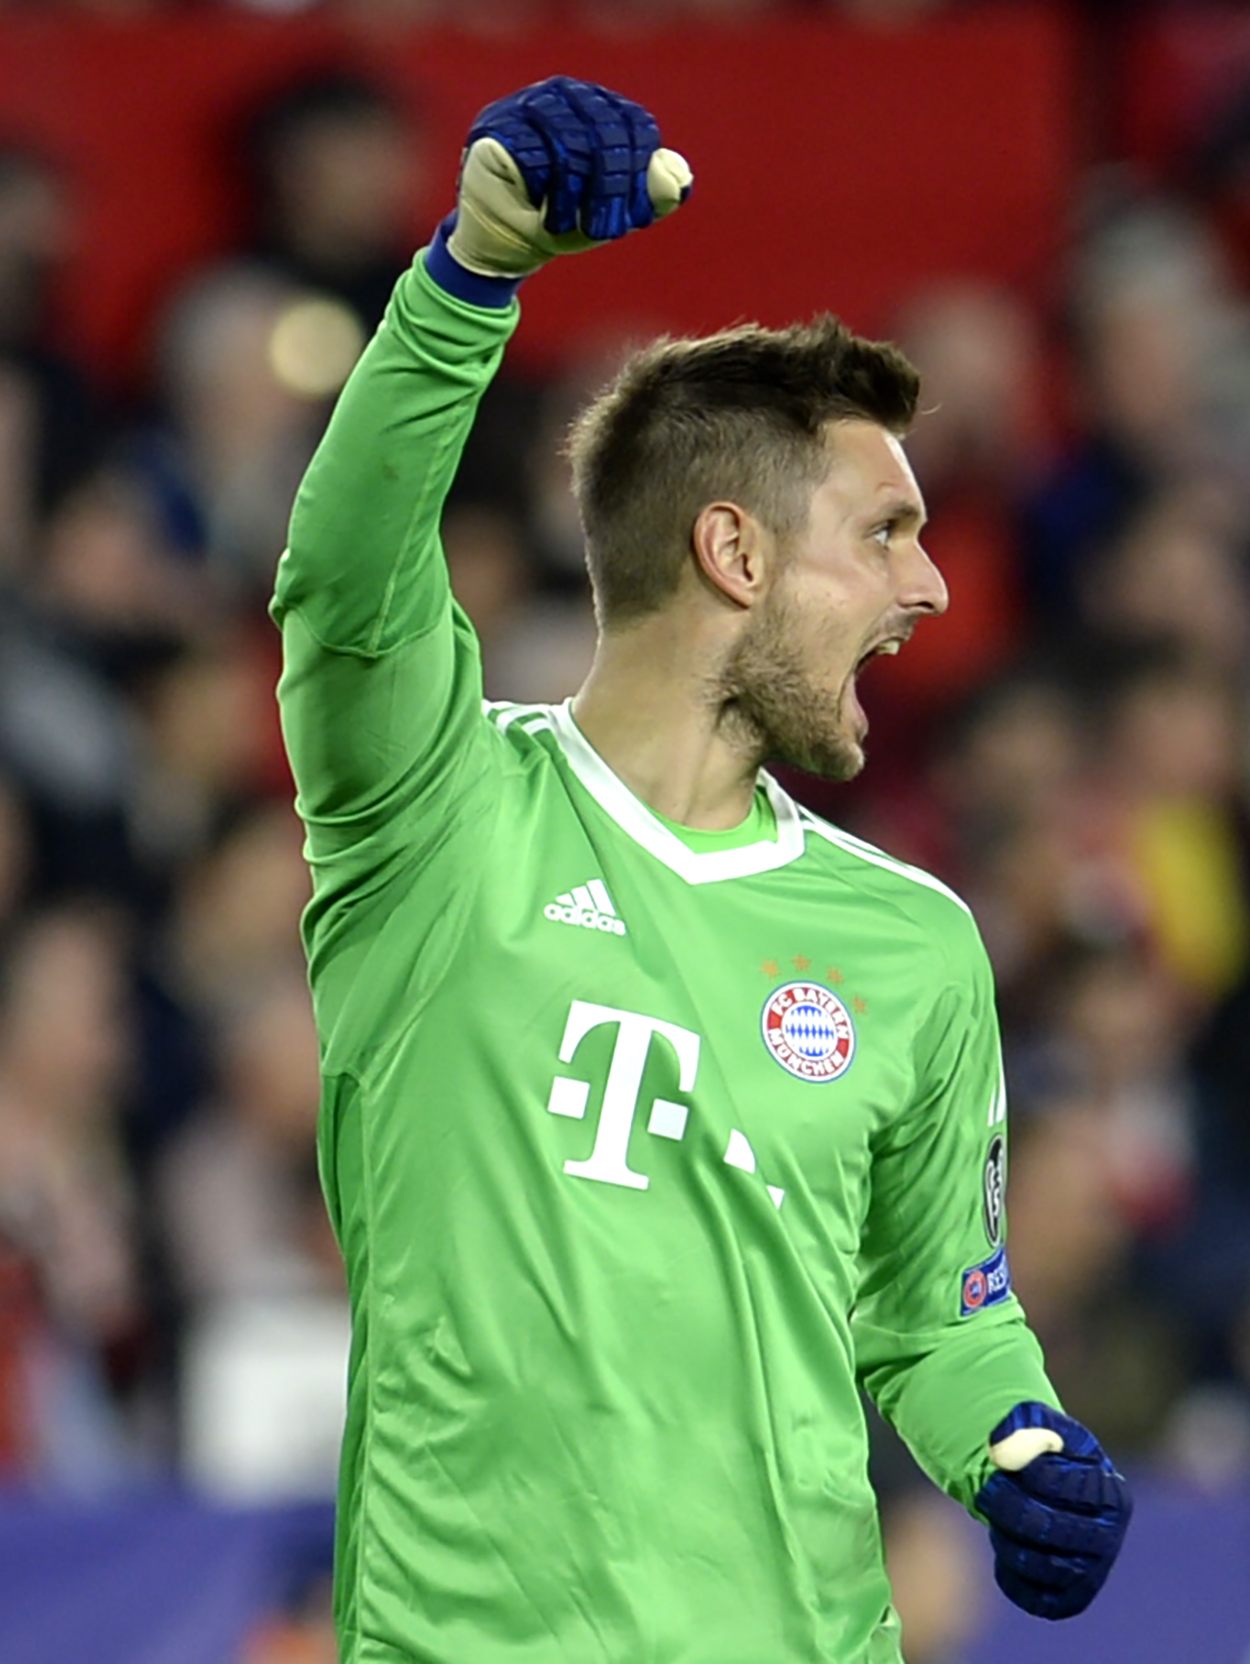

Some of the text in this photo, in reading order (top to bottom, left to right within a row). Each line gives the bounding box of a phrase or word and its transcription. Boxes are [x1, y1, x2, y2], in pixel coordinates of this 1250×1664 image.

[543, 903, 628, 936] adidas
[769, 987, 850, 1040] FC BAYERN
[553, 999, 701, 1191] T
